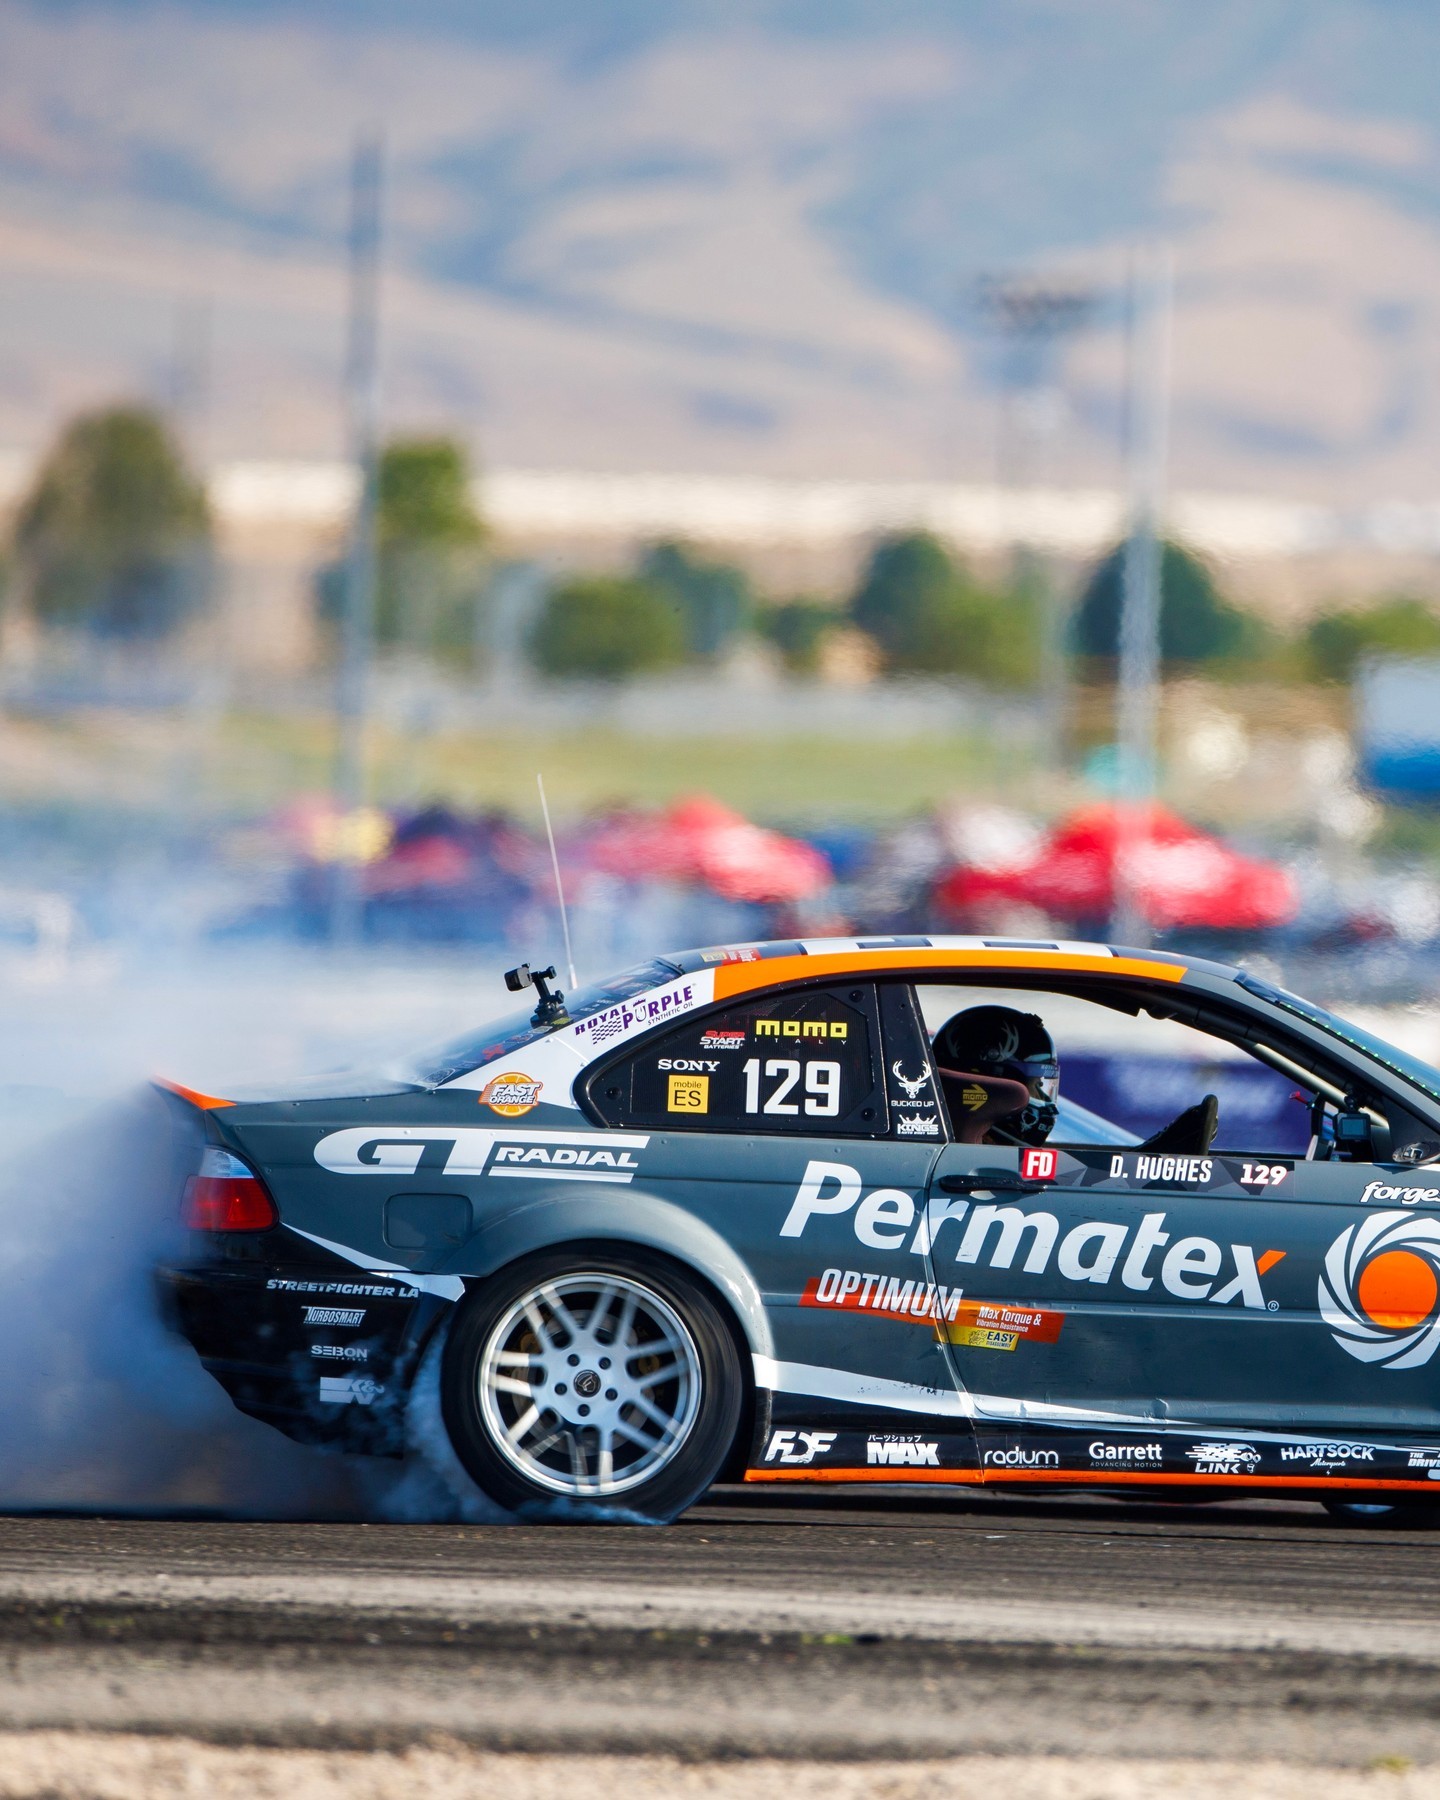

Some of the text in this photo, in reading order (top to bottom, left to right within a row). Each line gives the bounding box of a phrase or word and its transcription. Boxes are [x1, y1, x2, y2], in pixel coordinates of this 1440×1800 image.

[622, 985, 693, 1030] PURPLE
[648, 1001, 694, 1026] SYNTHETIC OIL
[575, 1004, 628, 1036] ROYAL
[699, 1036, 746, 1045] START
[705, 1030, 745, 1038] SUPER
[754, 1037, 847, 1045] ITALY
[657, 1058, 721, 1072] SONY
[492, 1083, 541, 1097] FAST
[673, 1081, 702, 1089] mobile
[742, 1058, 841, 1117] 129
[489, 1095, 535, 1105] ORANGE
[674, 1089, 702, 1107] ES
[890, 1100, 935, 1108] BUCKED UP
[897, 1123, 939, 1134] KINGS
[313, 1127, 651, 1176] GT RADIAL
[1026, 1151, 1054, 1177] FD
[1109, 1155, 1213, 1183] D. HUGHES
[1240, 1163, 1288, 1186] 129
[1360, 1181, 1440, 1205] forge
[266, 1279, 420, 1298] STREETFIGHTER LA
[815, 1268, 964, 1322] OPTIMUM
[301, 1306, 367, 1324] TURBOSMART
[978, 1306, 1042, 1326] Max Torque &
[976, 1319, 1029, 1333] Vibration Resistance
[986, 1331, 1015, 1343] EASY
[867, 1434, 922, 1443] パーツショップ
[867, 1442, 940, 1466] MAX
[984, 1446, 1059, 1465] radium
[1088, 1442, 1163, 1460] Garrett
[1280, 1444, 1375, 1461] HARTSOCK
[1194, 1462, 1241, 1474] LINK
